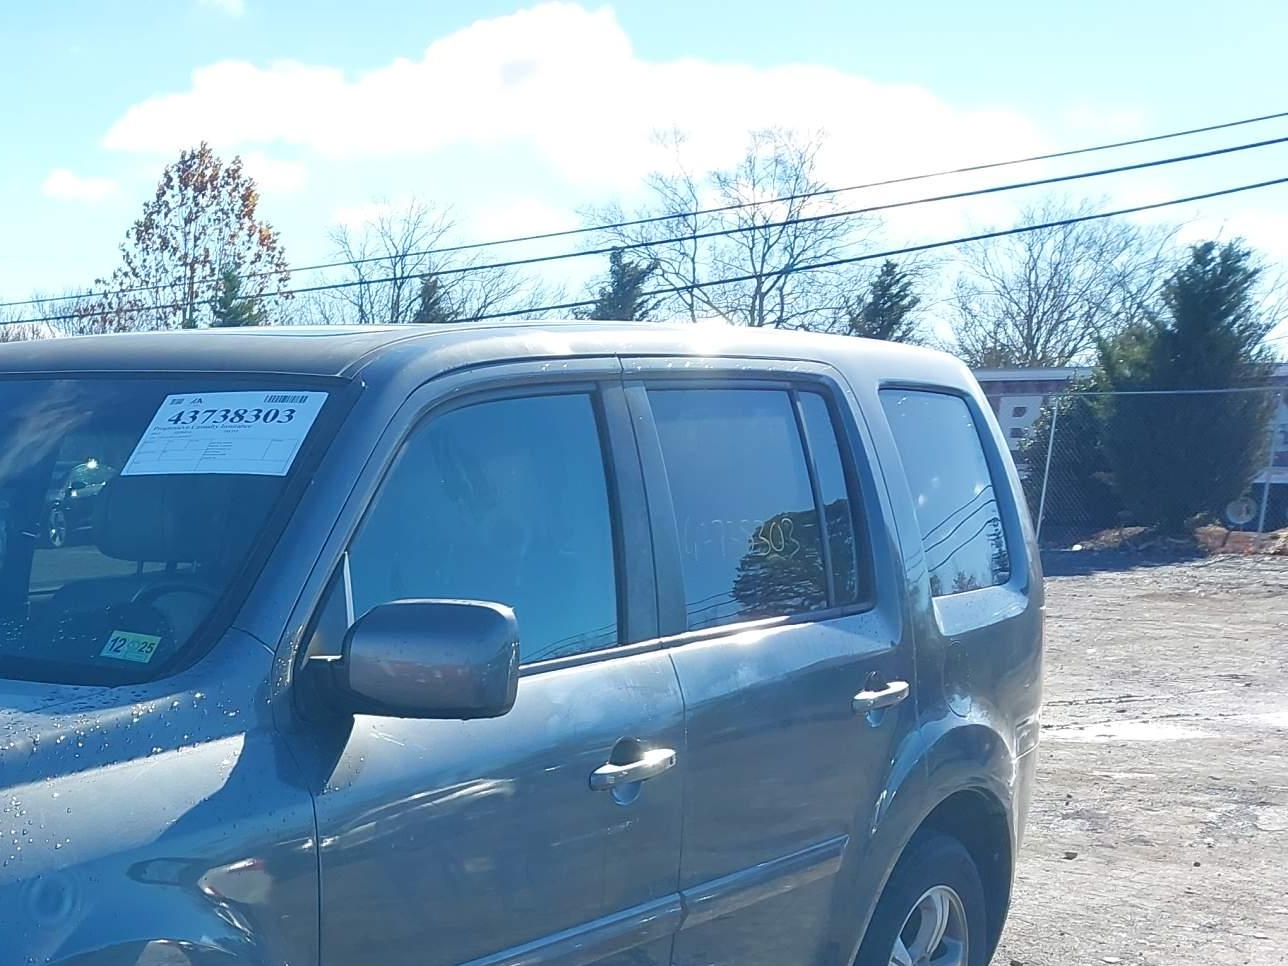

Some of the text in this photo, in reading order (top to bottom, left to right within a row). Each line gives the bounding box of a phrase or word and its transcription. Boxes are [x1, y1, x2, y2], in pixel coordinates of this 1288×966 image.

[167, 408, 297, 425] 43738303
[108, 636, 156, 654] 12 25
